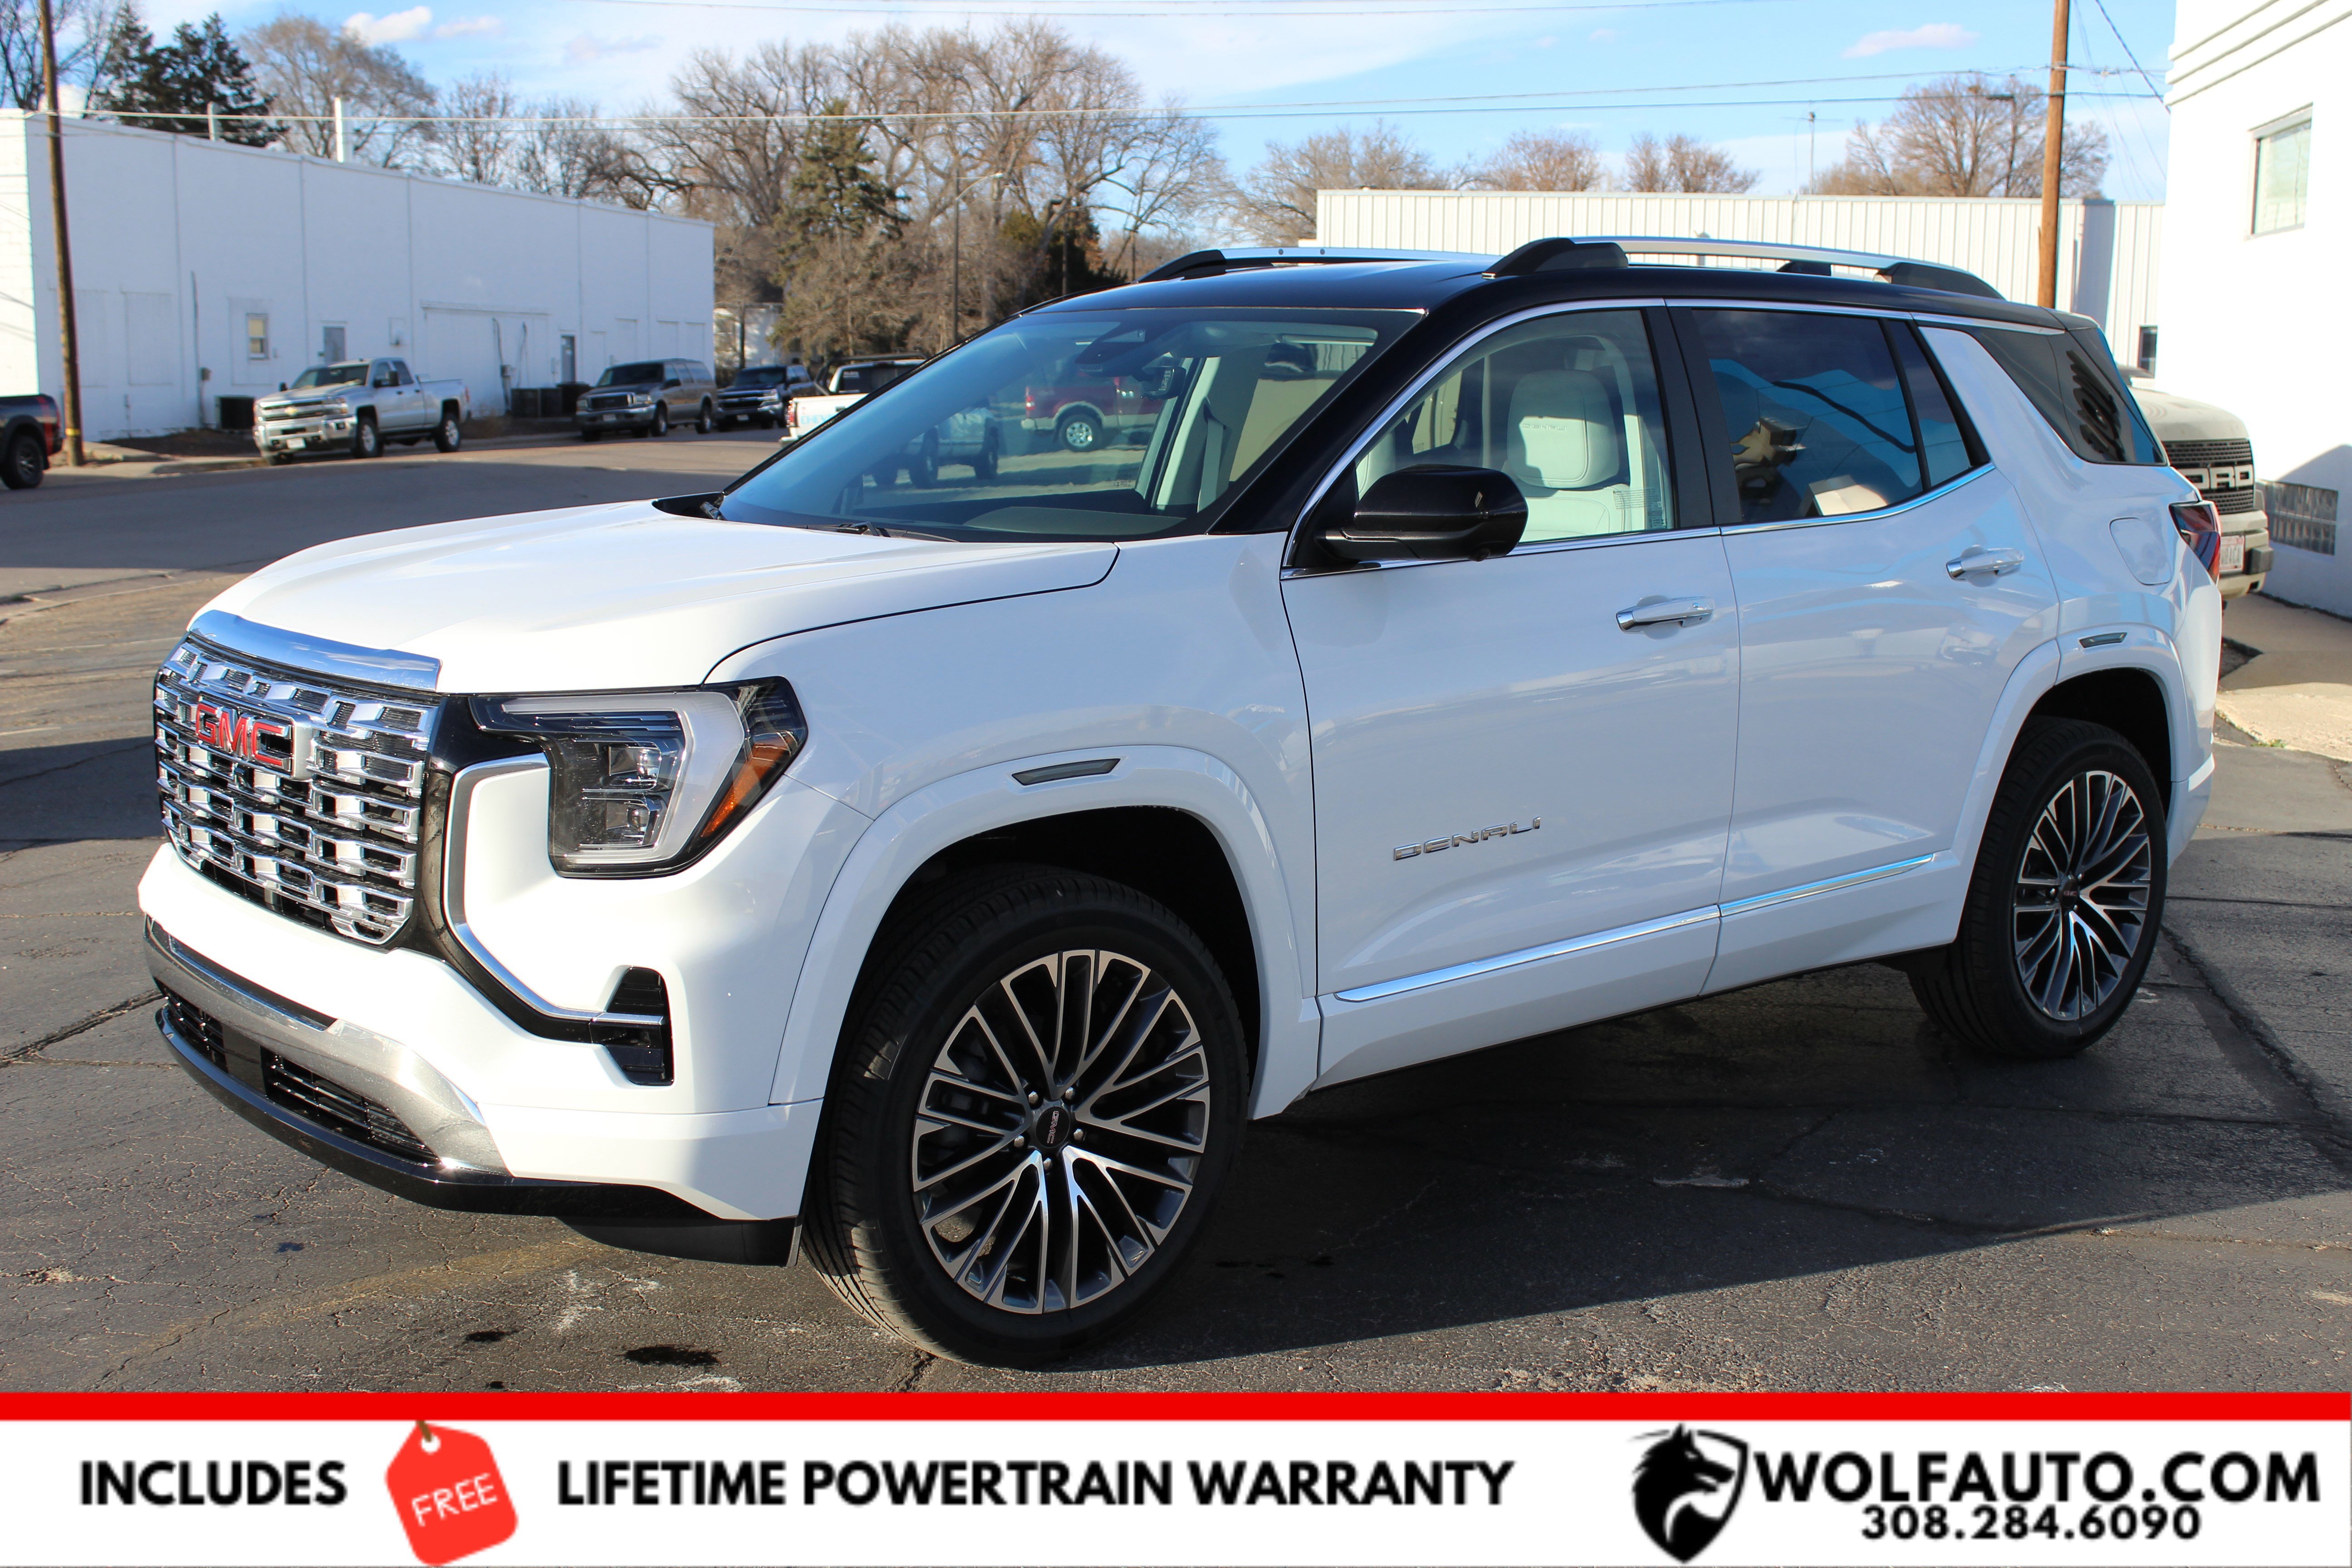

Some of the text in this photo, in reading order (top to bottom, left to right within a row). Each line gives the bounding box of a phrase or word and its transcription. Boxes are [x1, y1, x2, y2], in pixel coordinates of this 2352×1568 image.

[2179, 465, 2254, 490] ORD
[196, 703, 289, 770] GMC
[1393, 816, 1541, 861] DENALI
[1047, 1111, 1059, 1143] GMC
